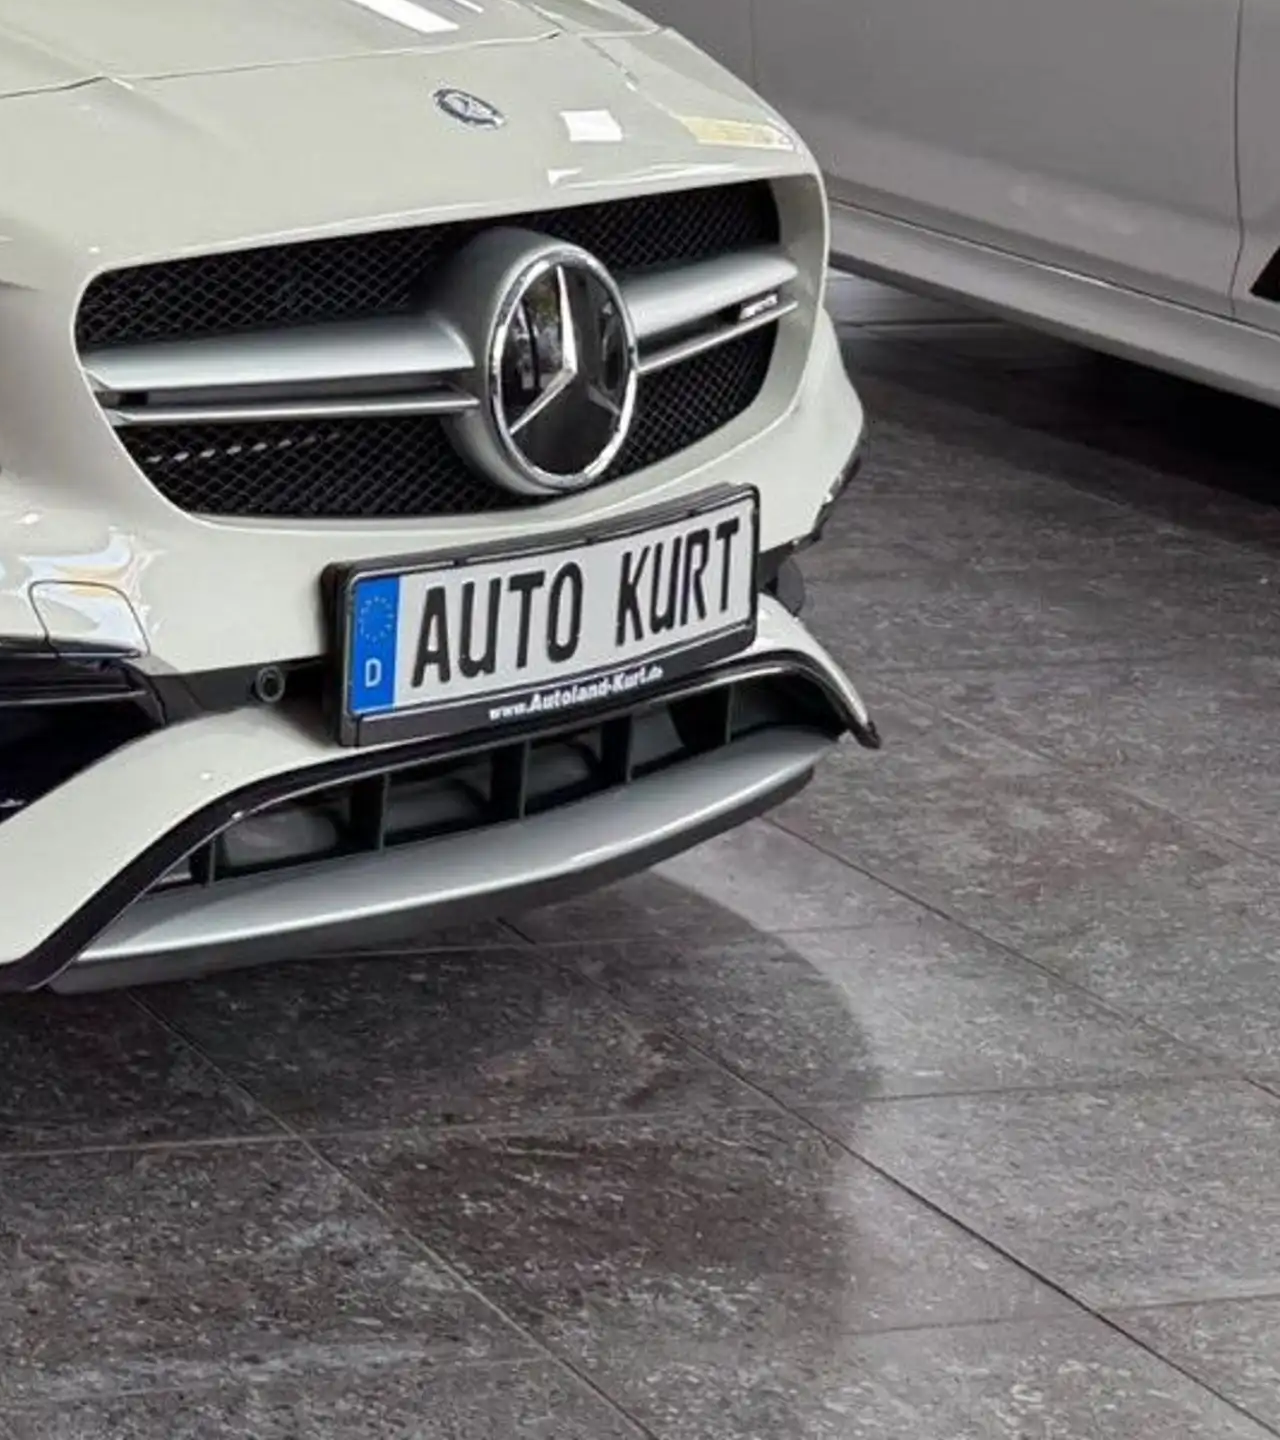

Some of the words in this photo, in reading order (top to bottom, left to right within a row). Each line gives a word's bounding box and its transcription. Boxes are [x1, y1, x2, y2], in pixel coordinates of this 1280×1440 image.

[411, 562, 583, 689] AUTO
[615, 518, 740, 647] KURT
[363, 657, 383, 688] D
